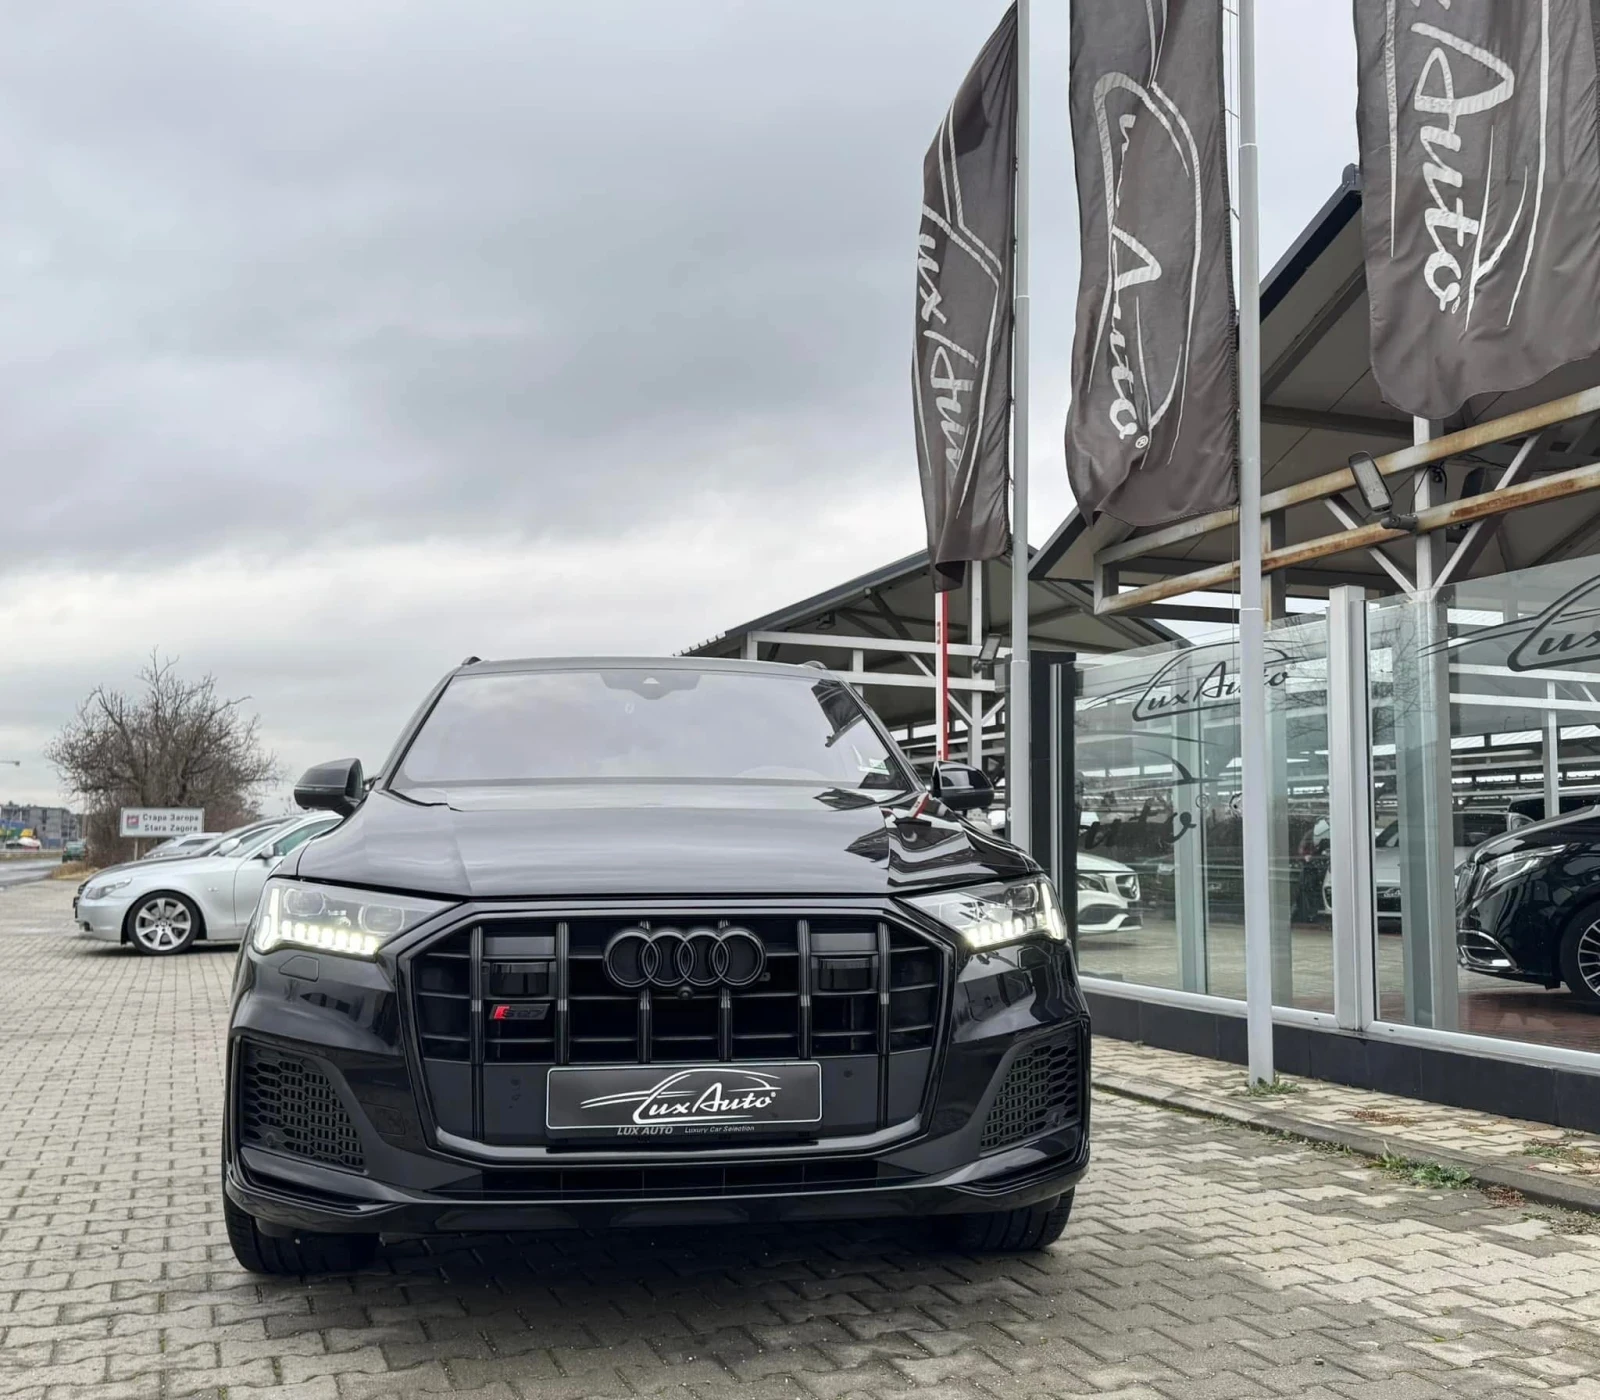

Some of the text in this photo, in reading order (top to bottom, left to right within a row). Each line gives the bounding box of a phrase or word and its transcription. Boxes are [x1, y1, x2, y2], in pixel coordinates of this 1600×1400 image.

[1411, 22, 1515, 312] Auto
[143, 813, 199, 822] Стара Загора
[144, 824, 198, 832] Stara Zagora
[632, 1082, 773, 1124] Lux Auto
[616, 1126, 639, 1136] LUX
[640, 1126, 674, 1135] AUTO
[684, 1126, 708, 1134] Luxury
[722, 1125, 755, 1133] Selection
